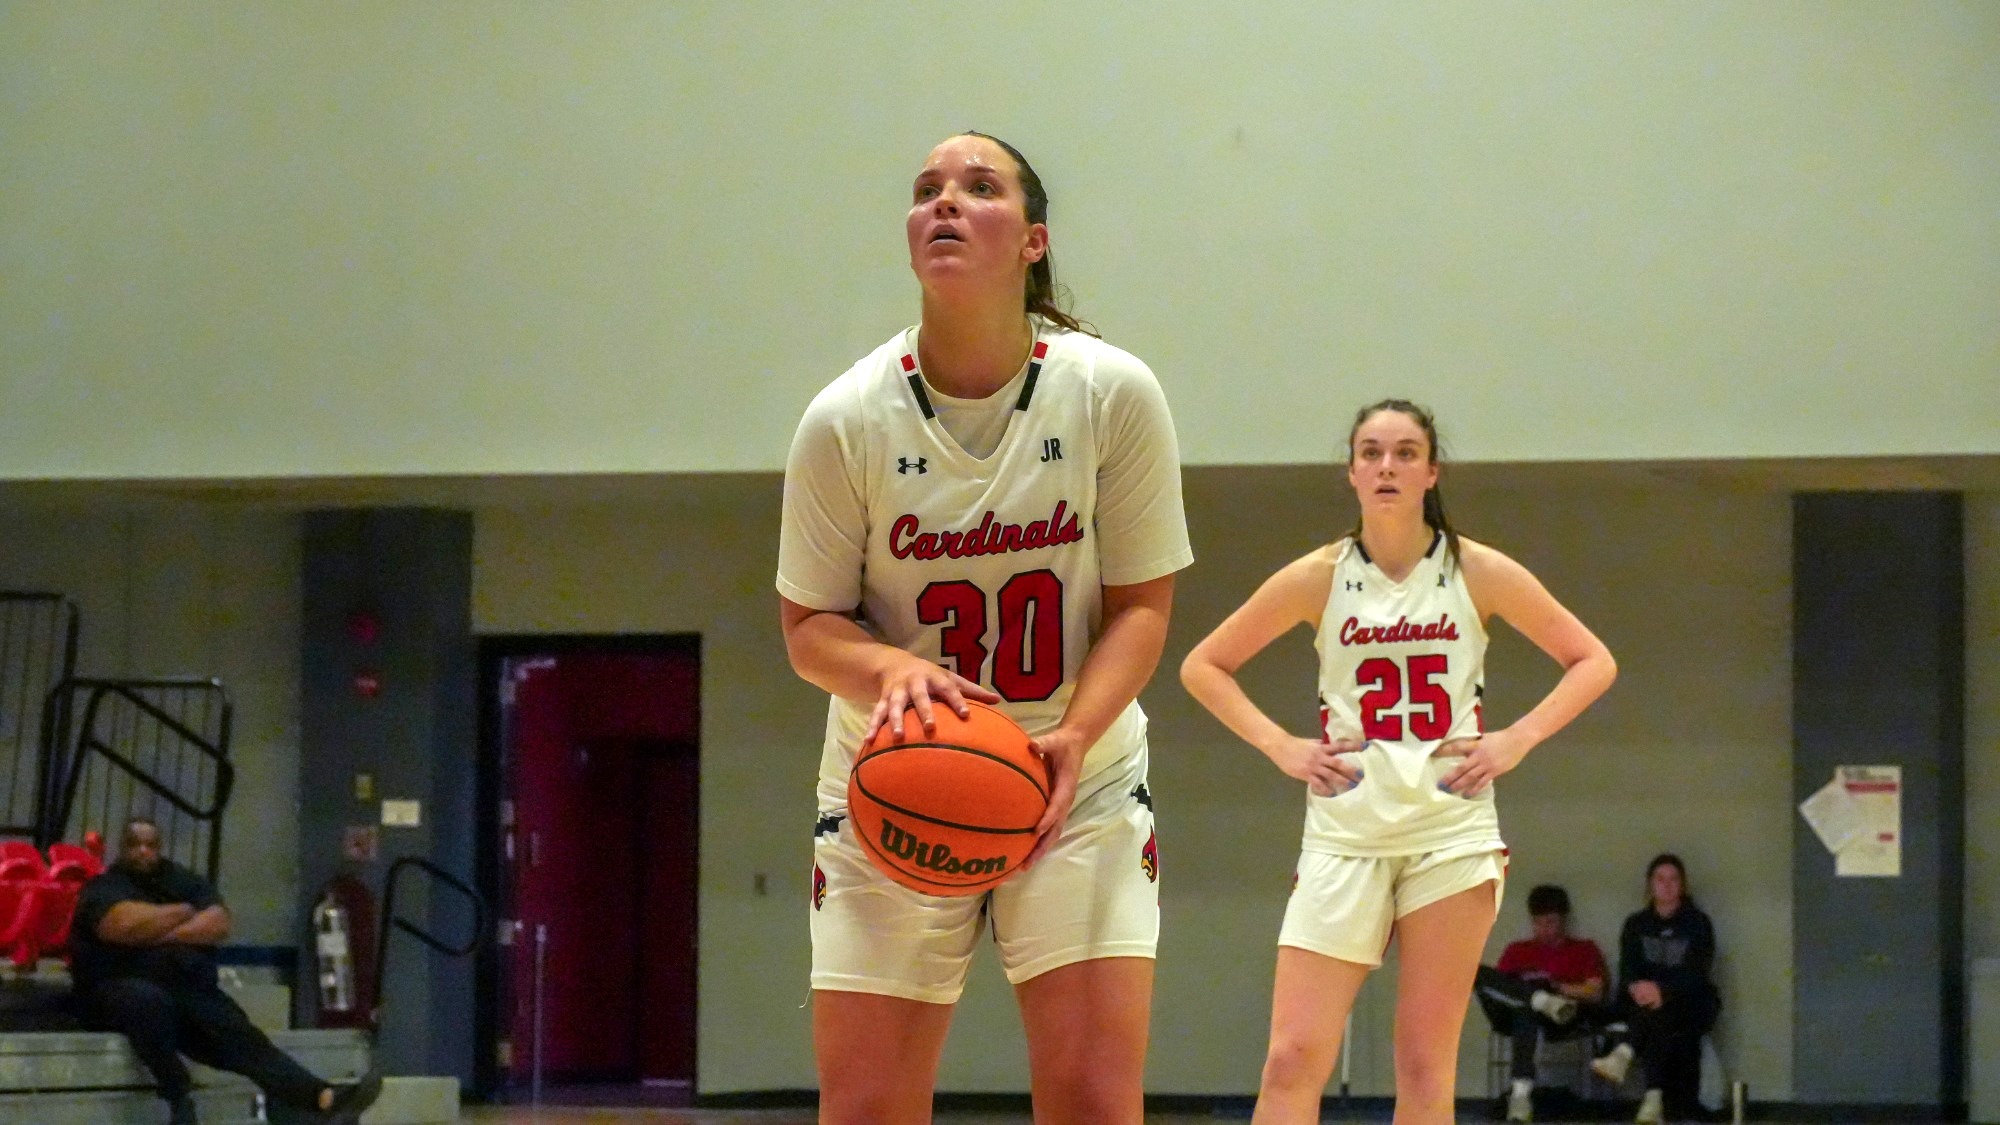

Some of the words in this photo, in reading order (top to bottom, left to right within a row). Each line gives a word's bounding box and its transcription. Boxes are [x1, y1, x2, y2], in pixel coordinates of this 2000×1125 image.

[1040, 438, 1063, 463] JR
[889, 500, 1084, 560] Cardinals
[916, 568, 1064, 703] 30
[1340, 613, 1460, 647] Cardinals
[1355, 654, 1453, 742] 25
[880, 817, 1008, 876] Wilson
